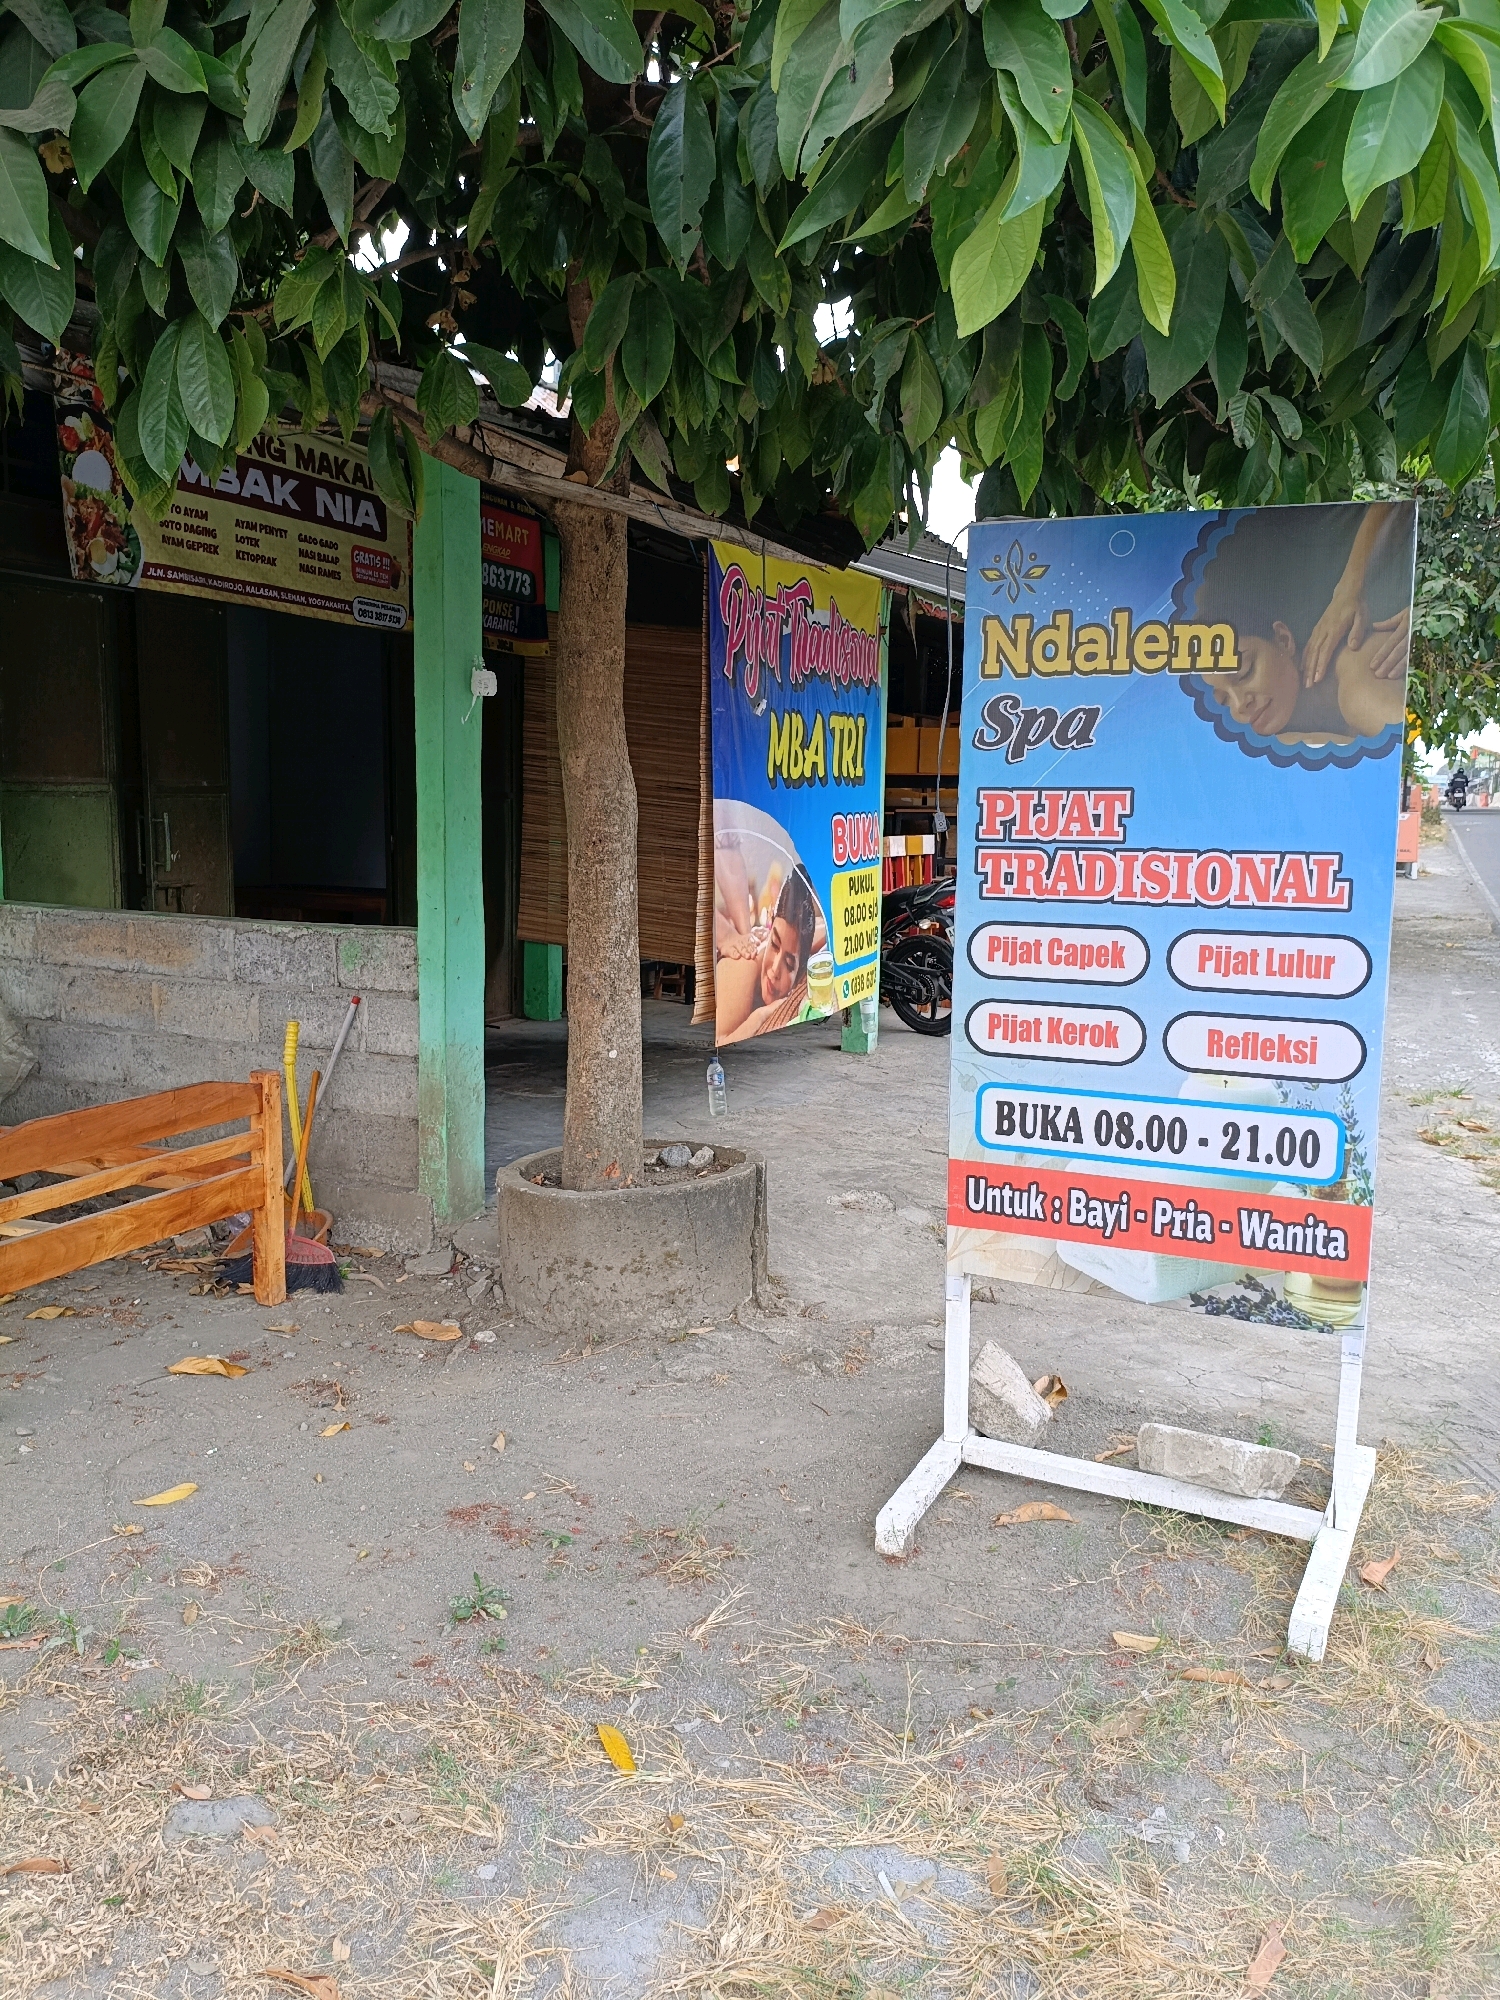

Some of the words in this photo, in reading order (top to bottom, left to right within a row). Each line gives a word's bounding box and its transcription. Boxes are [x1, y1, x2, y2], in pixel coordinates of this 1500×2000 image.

[178, 456, 301, 511] MBAK
[315, 486, 381, 533] NIA
[183, 506, 208, 521] AYAM
[235, 519, 257, 532] AYAM
[259, 523, 288, 539] PENYET
[162, 534, 185, 548] AYAM
[186, 540, 219, 555] GEPREK
[183, 522, 217, 539] DAGING
[235, 534, 260, 548] LOTEK
[298, 533, 318, 545] GADO
[319, 538, 338, 550] GADO
[235, 549, 277, 567] KETOPRAK
[298, 548, 316, 560] NASI
[317, 552, 340, 565] BALAP
[299, 563, 316, 575] NASI
[318, 567, 341, 580] RAMES
[354, 550, 381, 568] GRATIS
[147, 567, 165, 577] JLN.
[246, 585, 279, 599] KALASAN,
[979, 607, 1241, 680] Ndalem
[972, 693, 1102, 764] Spa
[767, 709, 828, 787] MBA
[829, 711, 866, 786] TRI
[976, 787, 1134, 843] PIJAT
[831, 812, 879, 867] BUKA
[848, 873, 874, 896] PUKUL
[975, 846, 1353, 912] TRADISIONAL
[844, 903, 866, 927] 08.00
[844, 931, 864, 956] 21.00
[988, 935, 1042, 966] Pijat
[1048, 938, 1125, 970] Capek
[1198, 945, 1259, 977] Pijat
[1265, 948, 1336, 980] Lulur
[988, 1013, 1042, 1043] Pijat
[1047, 1016, 1120, 1048] Kerok
[1207, 1028, 1318, 1065] Refleksi
[995, 1100, 1083, 1144] BUKA
[1094, 1109, 1188, 1154] 08.00
[1198, 1137, 1208, 1147] -
[1221, 1122, 1321, 1168] 21.00
[966, 1175, 1047, 1221] Untuk
[1051, 1196, 1063, 1224] :
[1067, 1187, 1131, 1239] Bayi
[1151, 1197, 1215, 1244] Pria
[1237, 1207, 1349, 1261] Wanita
